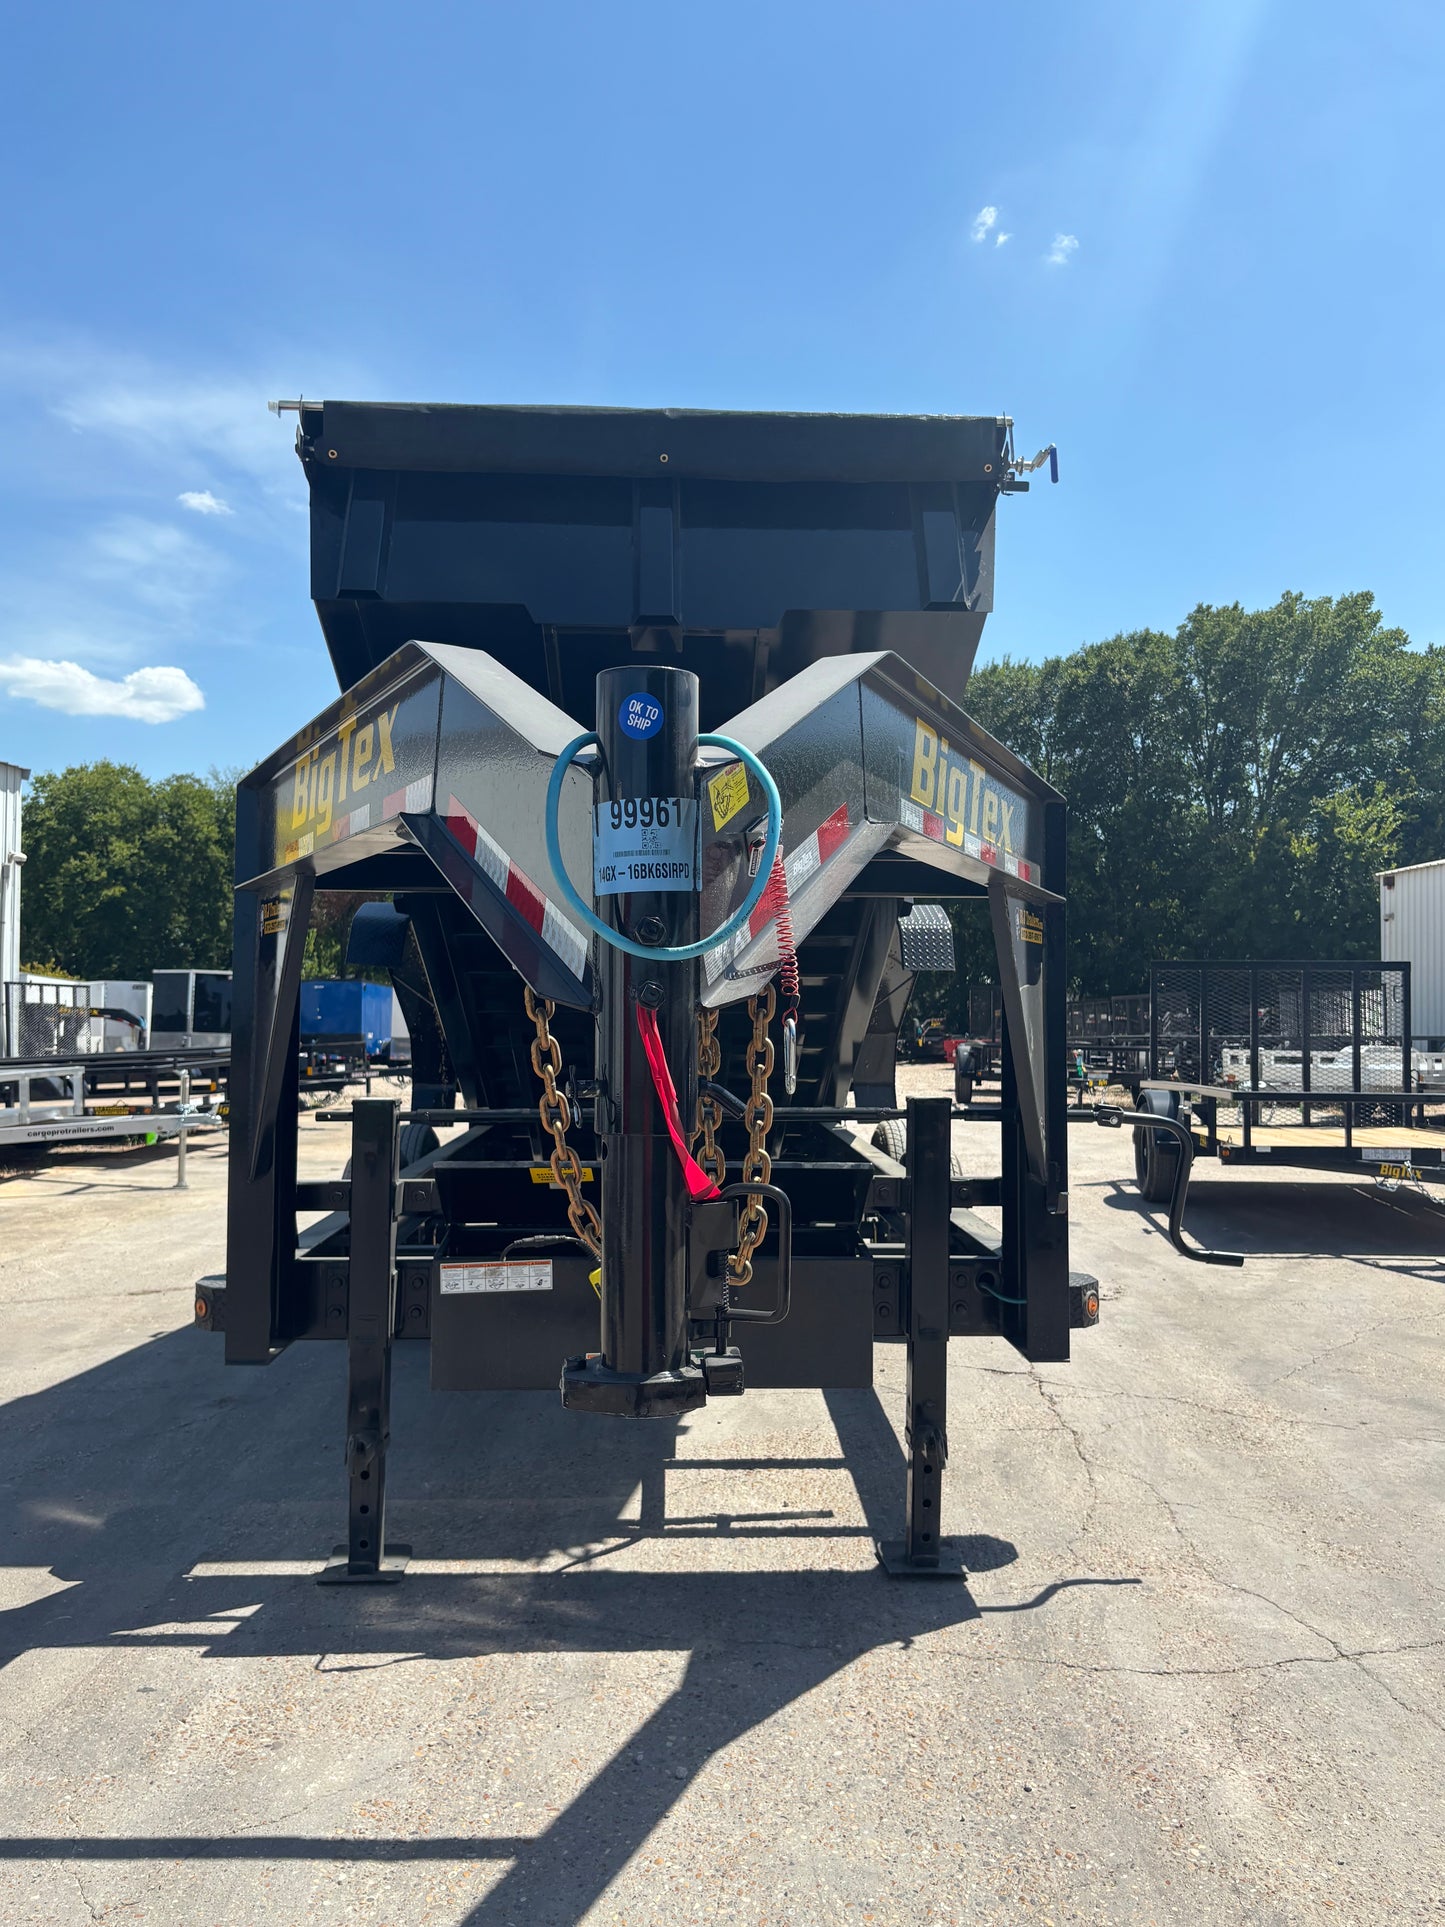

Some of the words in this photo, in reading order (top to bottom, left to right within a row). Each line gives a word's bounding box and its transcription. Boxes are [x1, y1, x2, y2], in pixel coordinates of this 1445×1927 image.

[628, 699, 644, 714] OK
[645, 705, 659, 720] TO
[627, 713, 651, 730] SHIP
[610, 798, 682, 829] 99961
[27, 1125, 115, 1138] cargoprotrailers.com
